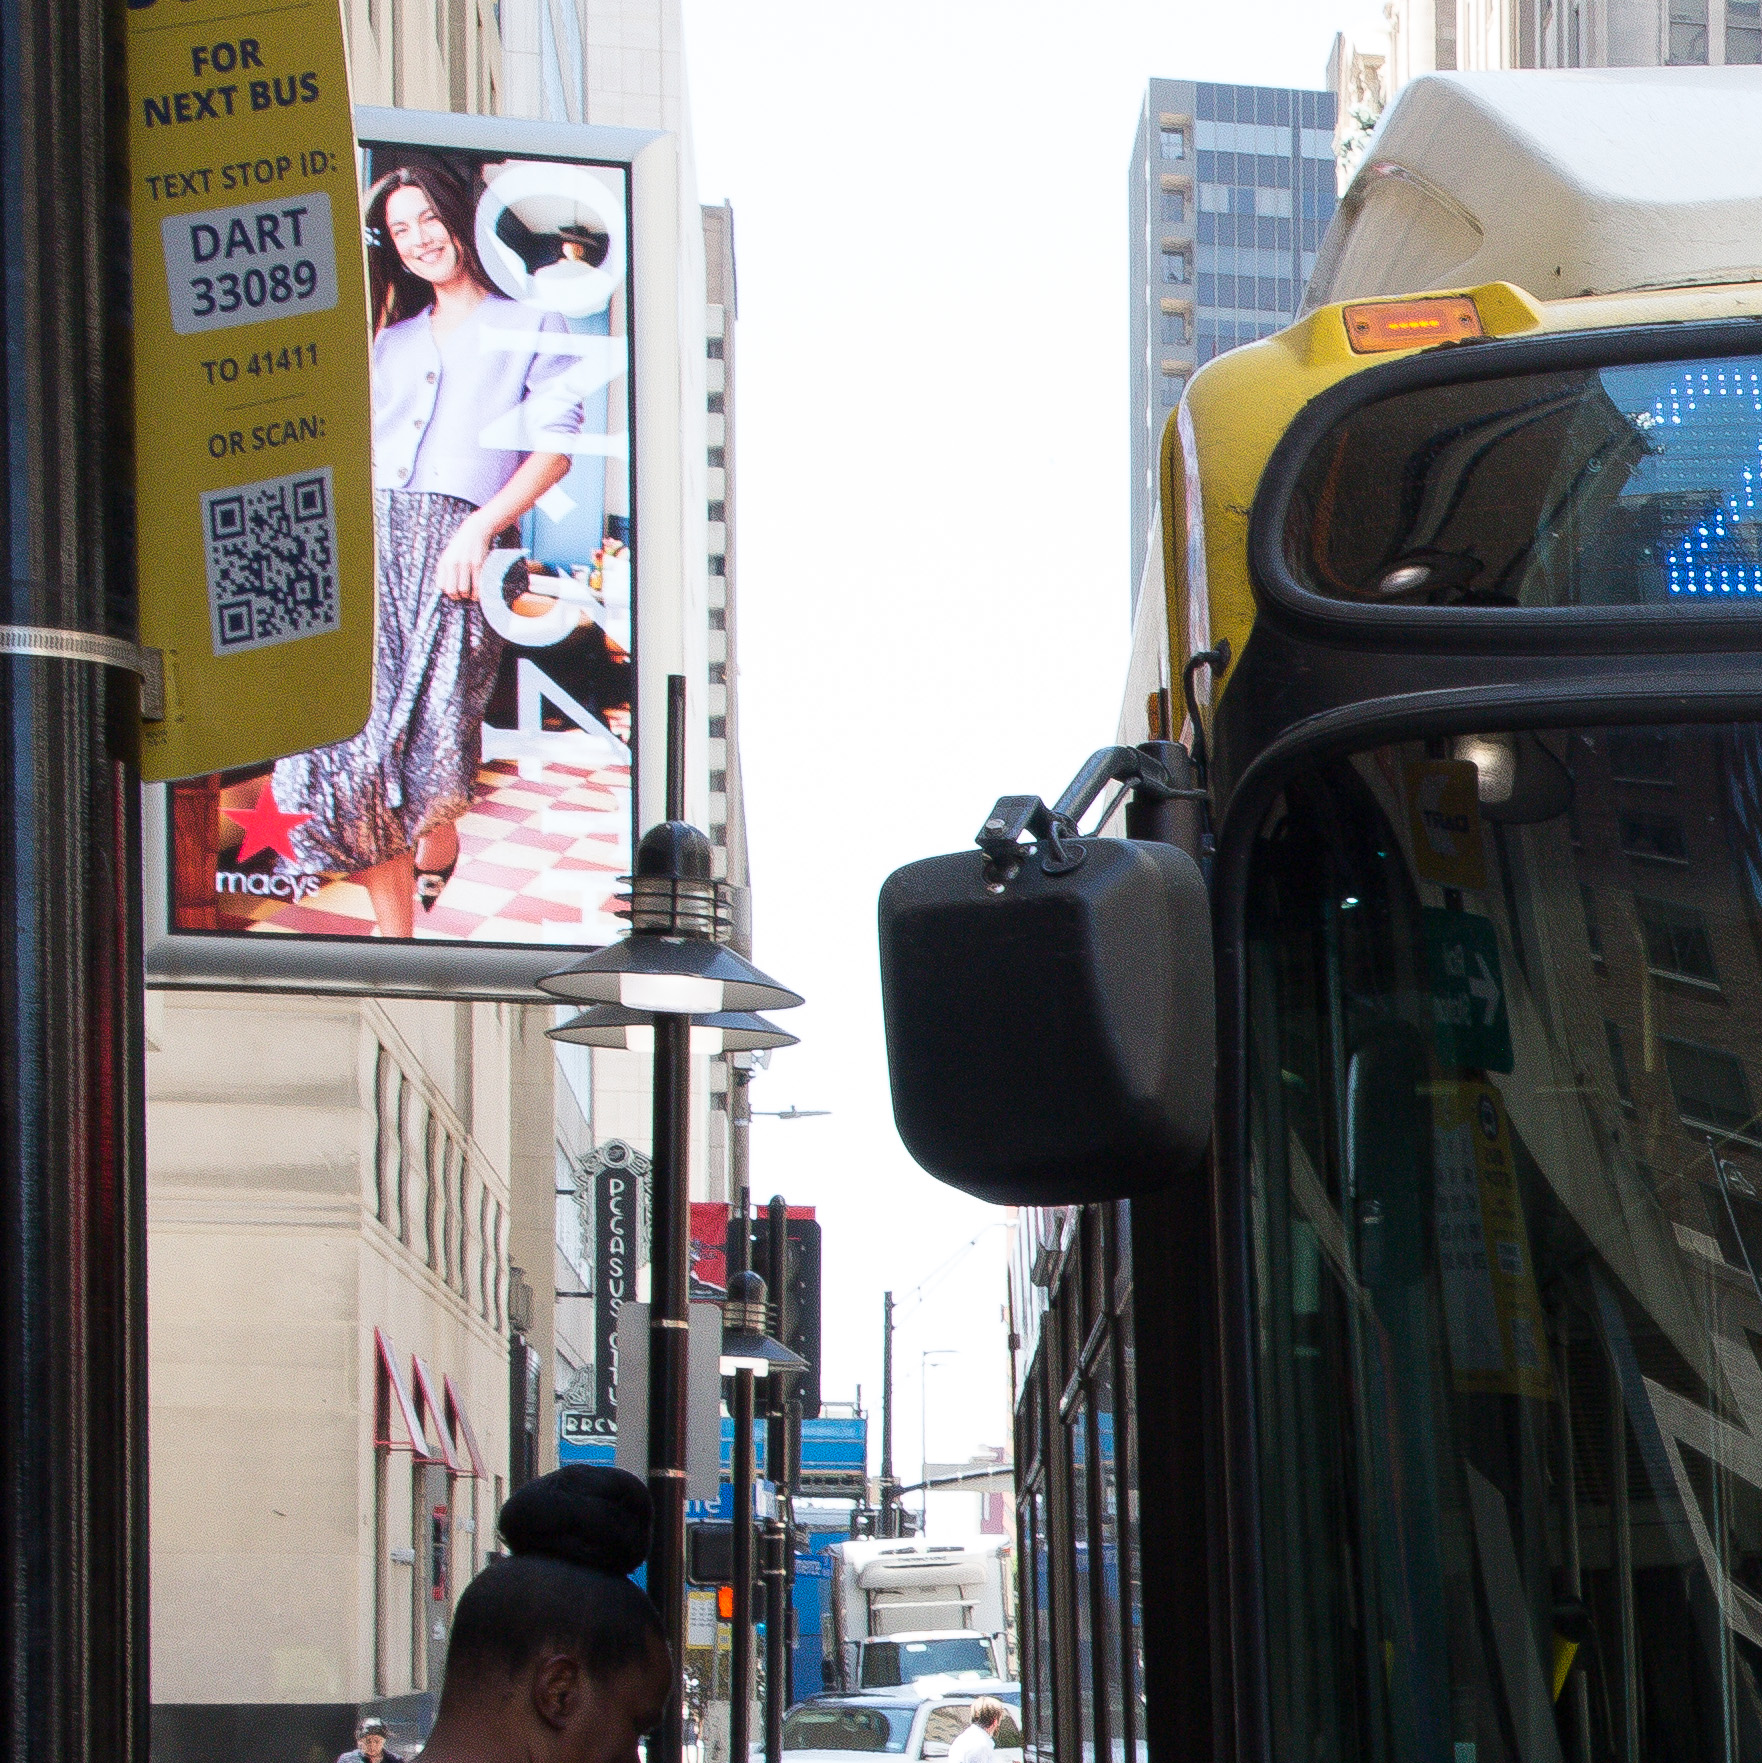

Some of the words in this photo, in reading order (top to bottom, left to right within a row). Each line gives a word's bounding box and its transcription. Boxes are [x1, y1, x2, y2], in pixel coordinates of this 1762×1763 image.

[191, 38, 264, 77] FOR
[143, 85, 237, 128] NEXT
[250, 72, 320, 111] BUS
[146, 168, 213, 201] TEXT
[221, 156, 292, 190] STOP
[300, 151, 337, 178] ID:
[190, 207, 309, 264] DART
[190, 259, 318, 317] 33089
[200, 358, 239, 385] TO
[247, 343, 318, 377] 41411
[208, 431, 246, 459] OR
[252, 415, 326, 451] SCAN:
[609, 1178, 625, 1318] PEGASUS
